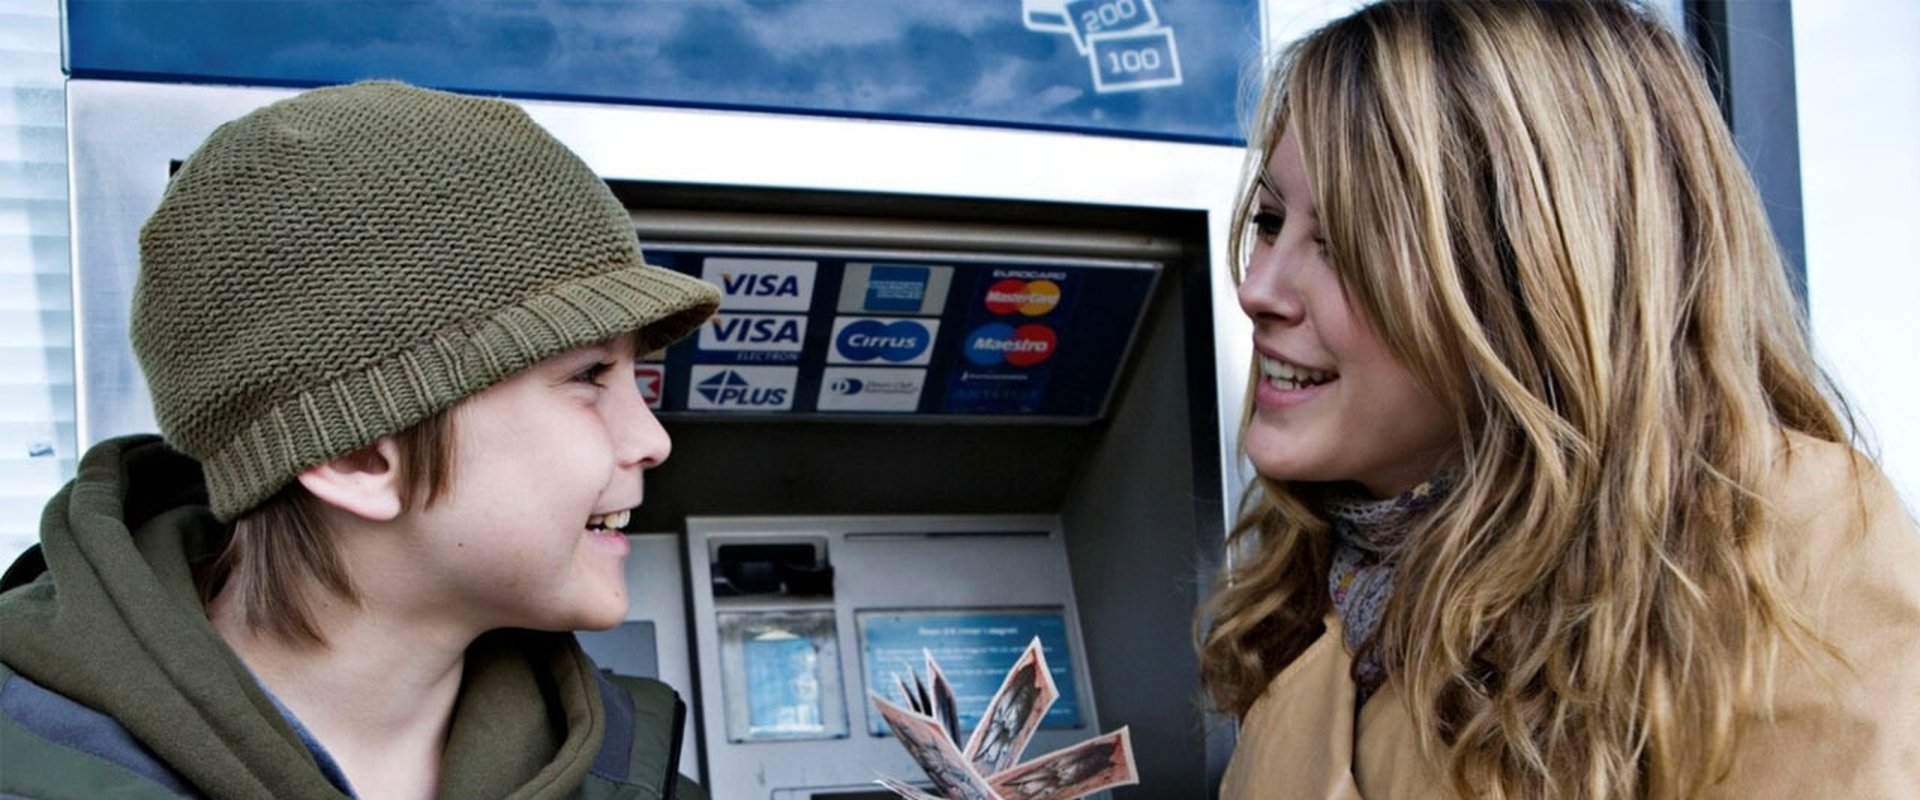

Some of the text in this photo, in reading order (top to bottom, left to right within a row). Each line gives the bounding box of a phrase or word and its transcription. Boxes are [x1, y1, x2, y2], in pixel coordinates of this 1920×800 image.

[1082, 0, 1137, 32] 200
[1109, 48, 1160, 73] 100
[993, 269, 1067, 280] EUROCARD
[721, 272, 799, 297] VISA
[711, 316, 800, 344] VISA
[847, 333, 917, 349] Cirrus
[973, 336, 1048, 353] Maestro
[736, 350, 799, 361] ELECTRON
[718, 387, 788, 406] PLUS
